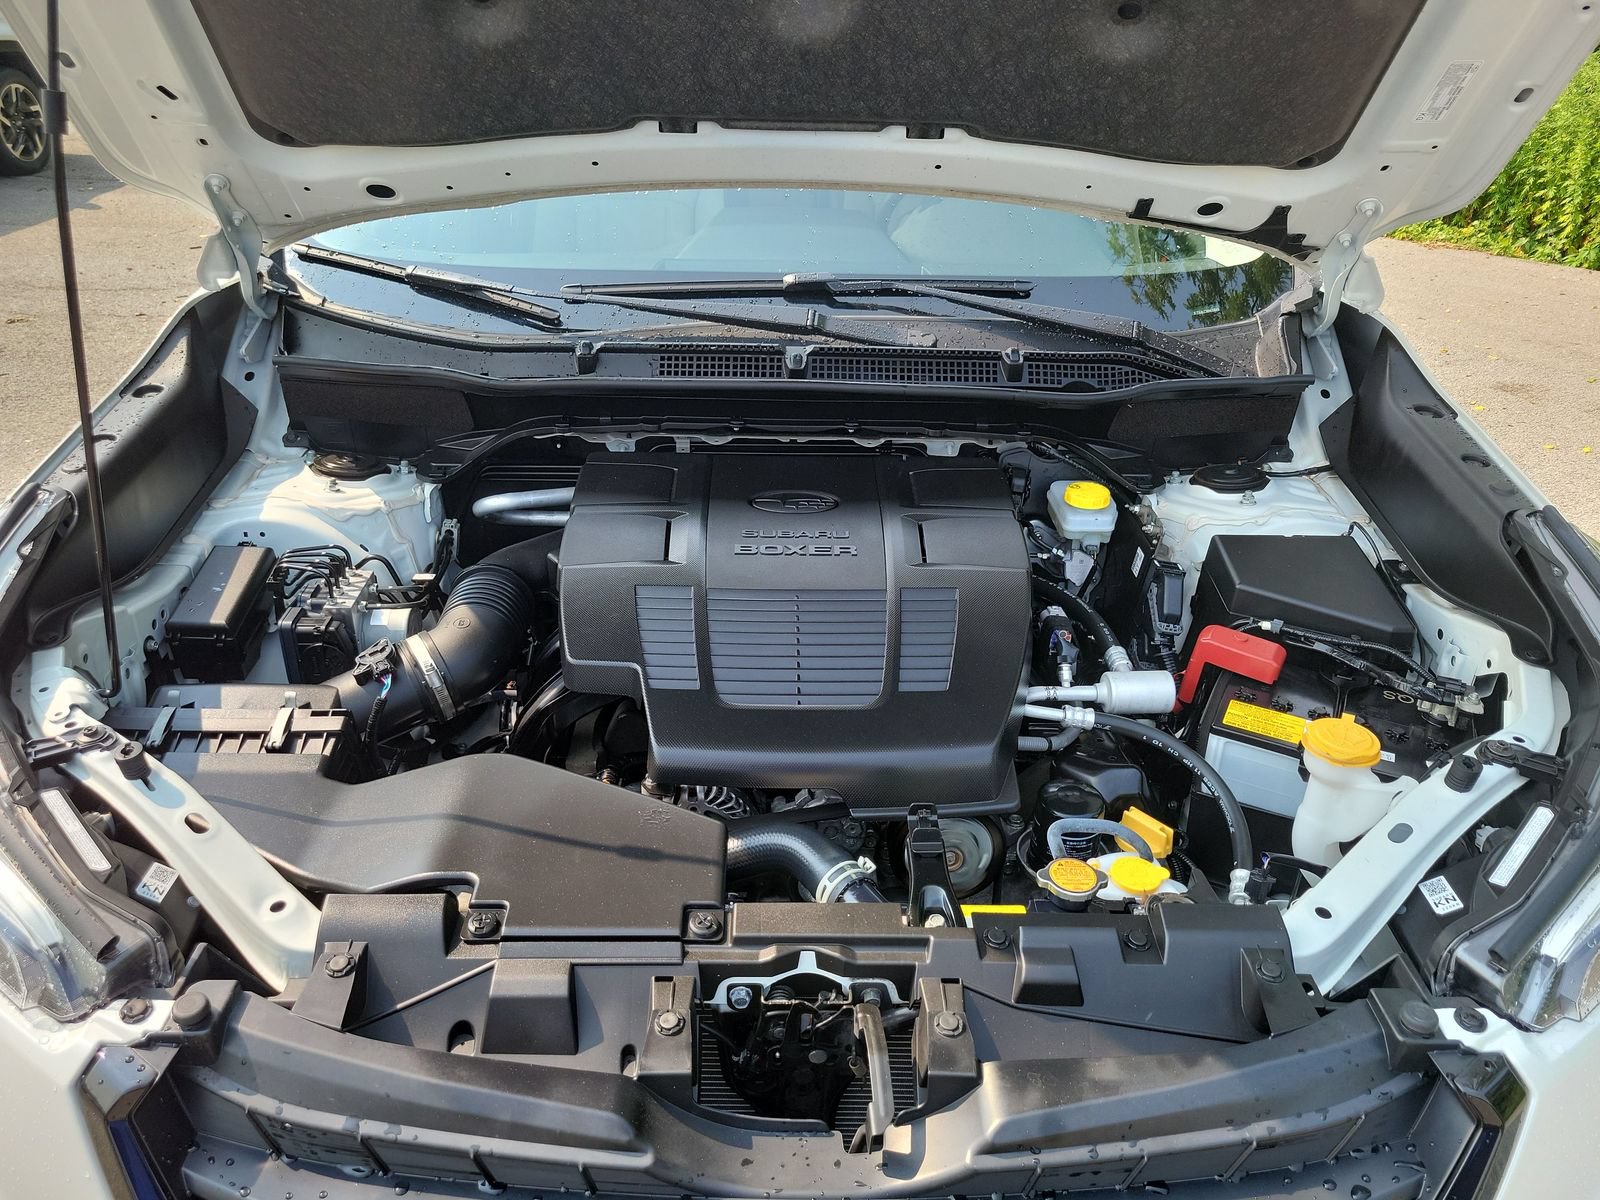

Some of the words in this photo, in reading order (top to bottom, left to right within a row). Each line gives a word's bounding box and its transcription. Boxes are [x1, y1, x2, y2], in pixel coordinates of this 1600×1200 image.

[741, 529, 850, 539] SUBARU
[734, 543, 858, 557] BOXER
[141, 882, 166, 896] KN
[1433, 895, 1458, 908] KN
